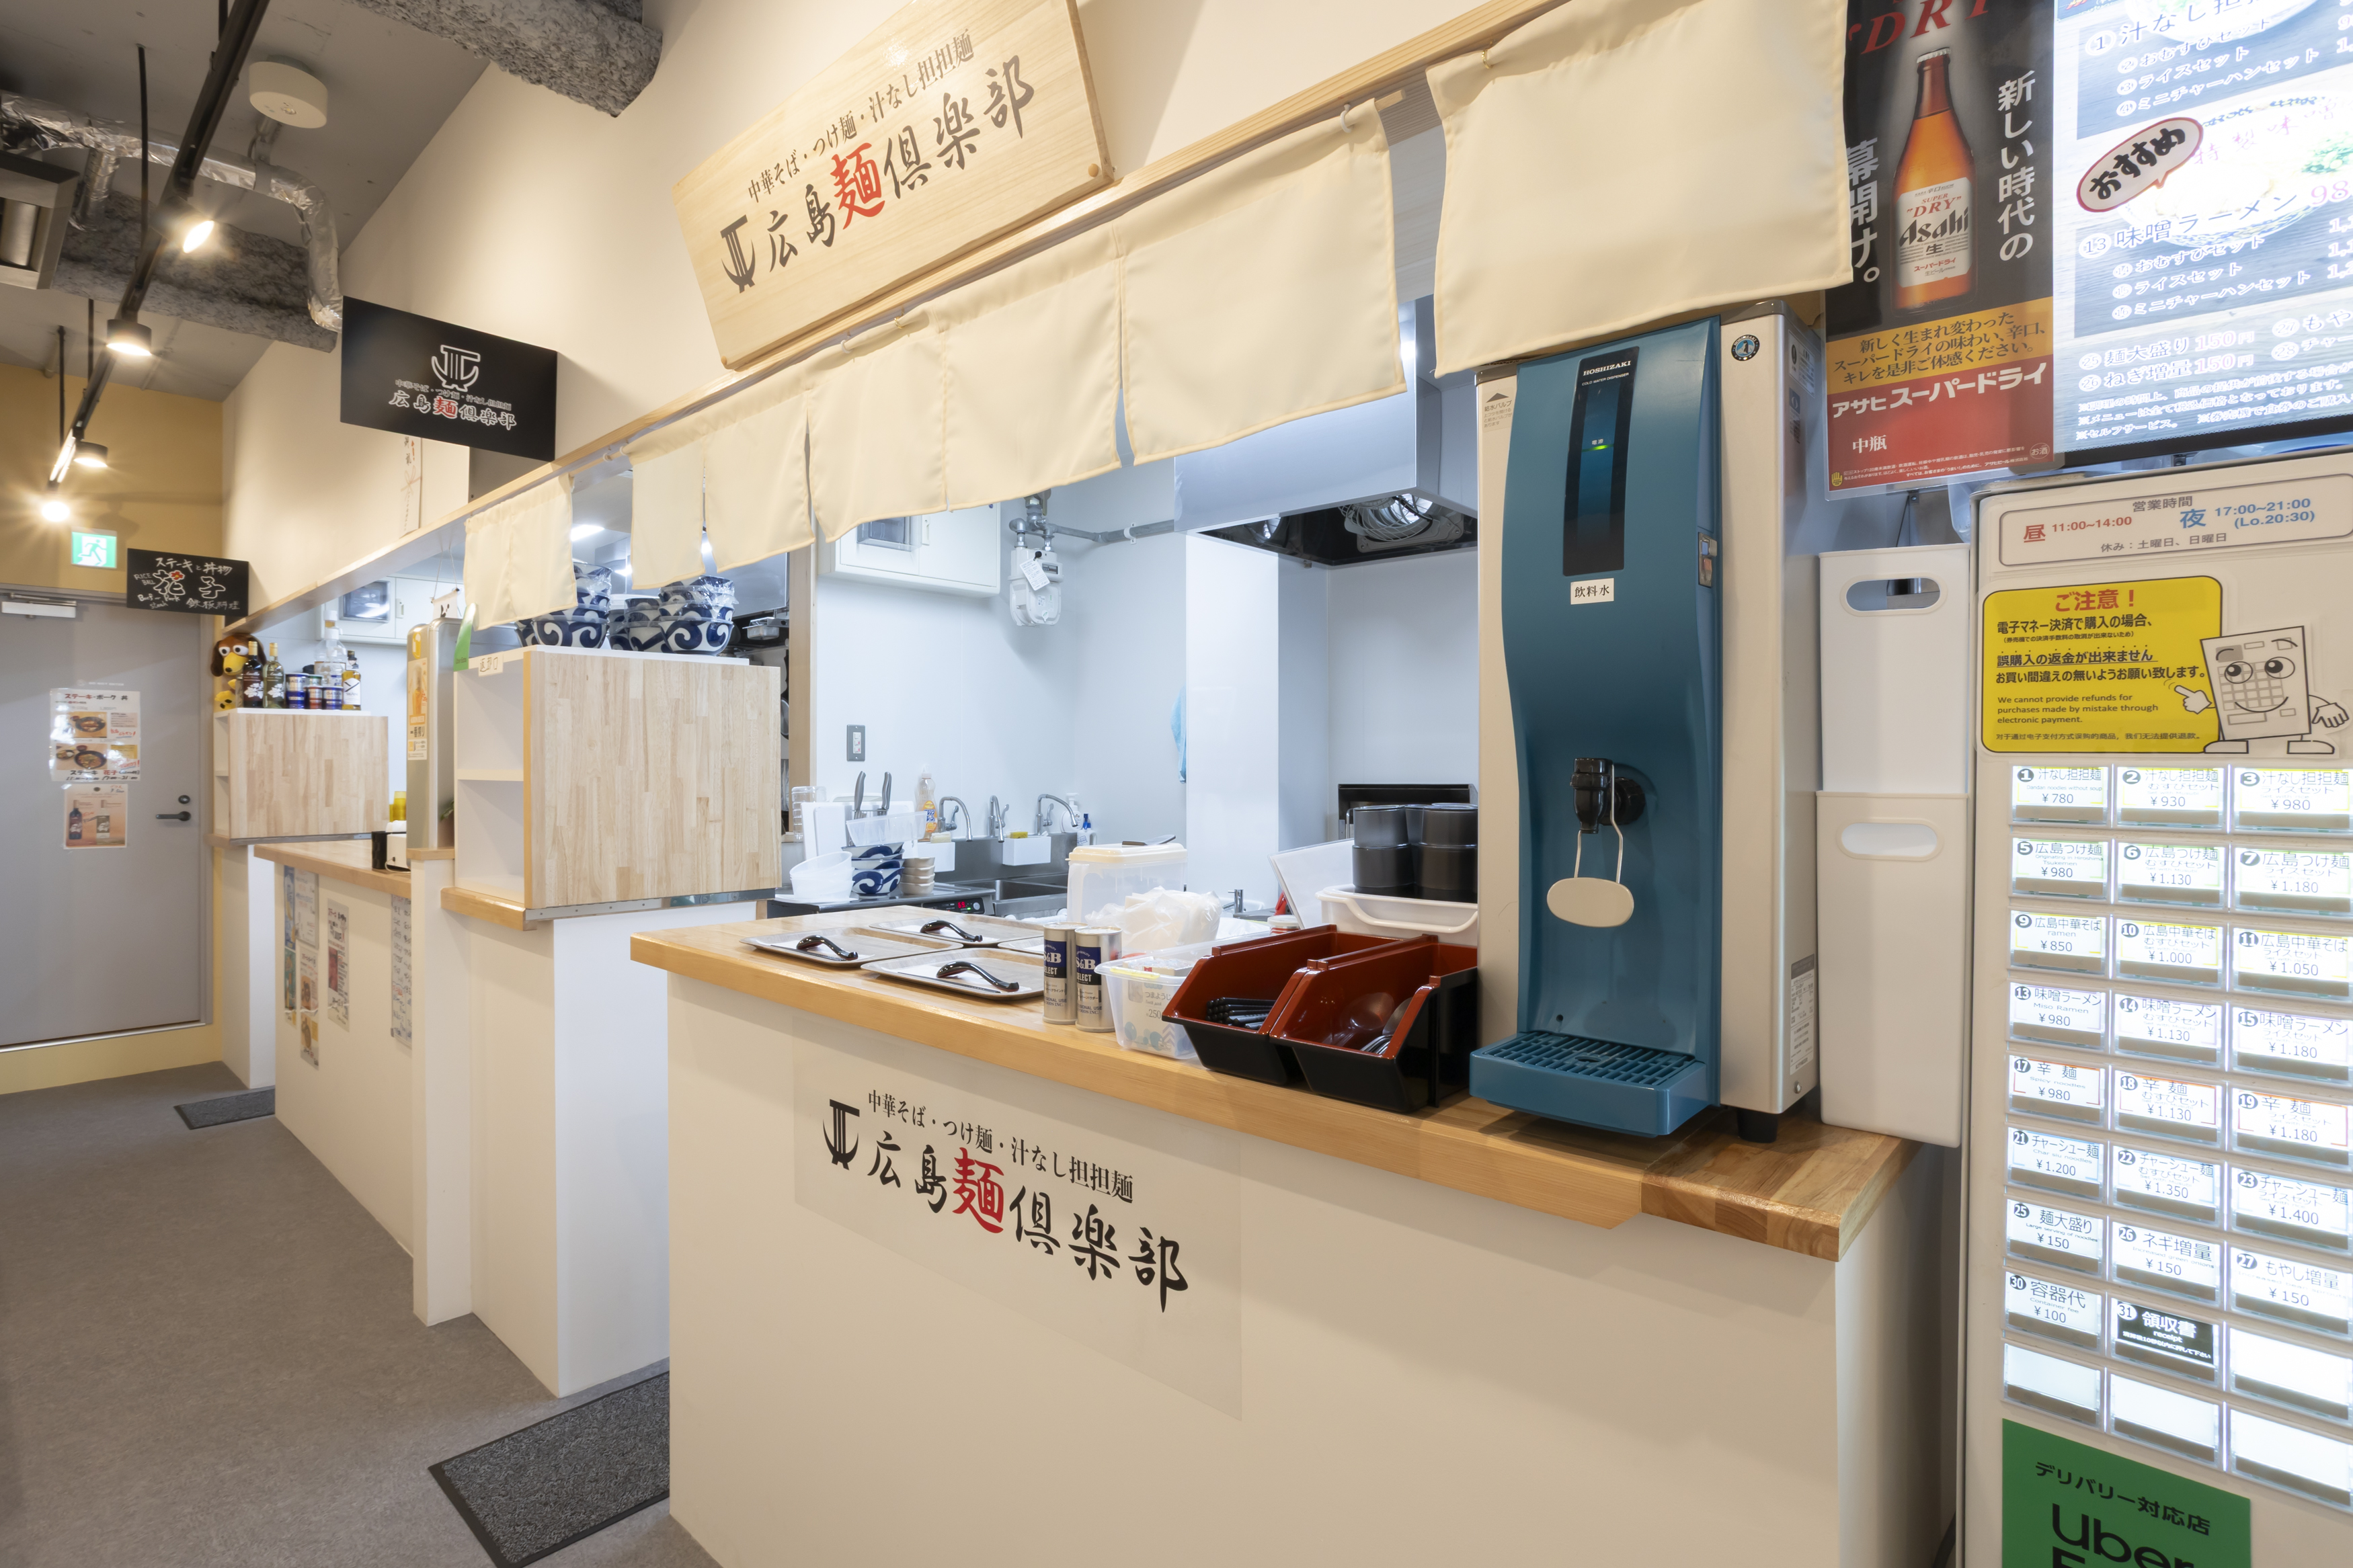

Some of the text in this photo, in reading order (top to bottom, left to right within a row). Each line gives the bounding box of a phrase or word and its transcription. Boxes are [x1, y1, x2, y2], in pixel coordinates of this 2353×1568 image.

[2140, 19, 2272, 67] おむすびセット
[2139, 46, 2249, 89] ライスセット
[2138, 48, 2319, 110] ミニチャーハンセット
[767, 54, 1035, 274] 広島麺倶楽部
[1998, 71, 2036, 261] 新しい時代の
[2089, 128, 2186, 200] おすすめ
[1921, 193, 1948, 204] SUPER
[1899, 206, 1968, 247] Asahi
[2115, 194, 2297, 248] 味噌ラーメン
[1925, 243, 1944, 256] 生
[2136, 235, 2265, 272] おむすびセット
[1914, 257, 1956, 272] スーパードライ
[2135, 263, 2242, 294] ライスセット
[2135, 270, 2311, 314] ミニチャーハンセット
[1860, 312, 2014, 354] 新しく生まれ変わった
[1833, 322, 2045, 372] スーパードライの味わい、辛口、
[2104, 337, 2190, 366] 麺大盛り
[1583, 361, 1631, 376] HOSHIZAKI
[1843, 341, 2033, 384] キレを是非ご体感ください。
[1607, 372, 1629, 380] DISPENSER
[2104, 360, 2192, 388] ねぎ増量
[389, 390, 517, 431] 広島麺倶楽部
[1852, 435, 1887, 455] 中瓶
[2031, 446, 2048, 456] お酒
[2132, 495, 2193, 513] 営業時間
[2180, 498, 2311, 528] 夜 17:00~21:00
[2023, 516, 2132, 543] 昼 11:00~14:00
[2234, 511, 2315, 529] (Lo.20:30)
[1574, 583, 1610, 598] 飲料水
[2055, 589, 2135, 612] ご注意！
[1997, 613, 2152, 634] 電子マネー決済で購入の場合、
[1997, 649, 2153, 666] 誤購入の返金が出来ません
[1996, 665, 2205, 684] お買い間違えの無いようお願い致します。
[1997, 706, 2040, 714] purchases
[2069, 705, 2080, 714] by
[2082, 704, 2118, 712] mistake
[2120, 704, 2158, 712] through
[2046, 694, 2079, 704] provide
[2081, 694, 2116, 702] refunds
[2118, 693, 2132, 701] for
[2041, 715, 2083, 725] payment.
[2038, 767, 2102, 781] 汁なし担担麺
[2145, 770, 2219, 782] 汁なし担担麺
[2262, 772, 2349, 786] 汁なし担担麺
[2035, 843, 2102, 856] 広島つけ麺
[2145, 847, 2218, 861] 広島つけ麺
[2262, 852, 2349, 869] 広島つけ麺
[2264, 866, 2337, 876] ライスセット
[2035, 917, 2101, 931] 広島中華そば
[2143, 925, 2216, 939] 広島中華そば
[2261, 934, 2348, 952] 広島中華そば
[1145, 992, 1171, 1001] つまようじ
[2035, 988, 2102, 1005] 味噌ラーメン
[2057, 1005, 2089, 1014] Ramen
[2143, 999, 2217, 1018] 味噌ラーメン
[2260, 1012, 2348, 1035] 味噌ラーメン
[2032, 1135, 2099, 1159] チャーシュー麺
[2140, 1154, 2213, 1178] チャーシュー麺
[2260, 1176, 2348, 1206] チャーシュー麺
[867, 1130, 1189, 1313] 広島麺倶楽部
[2040, 1209, 2092, 1234] 麺大盛り
[2143, 1233, 2212, 1262] ネギ増量
[2266, 1260, 2340, 1290] もやし増量
[2030, 1280, 2086, 1309] 容器代
[2030, 1297, 2065, 1310] Container
[2141, 1311, 2197, 1339] 領収書
[2153, 1330, 2183, 1344] receipt
[2035, 1462, 2211, 1536] デリバリー対応店
